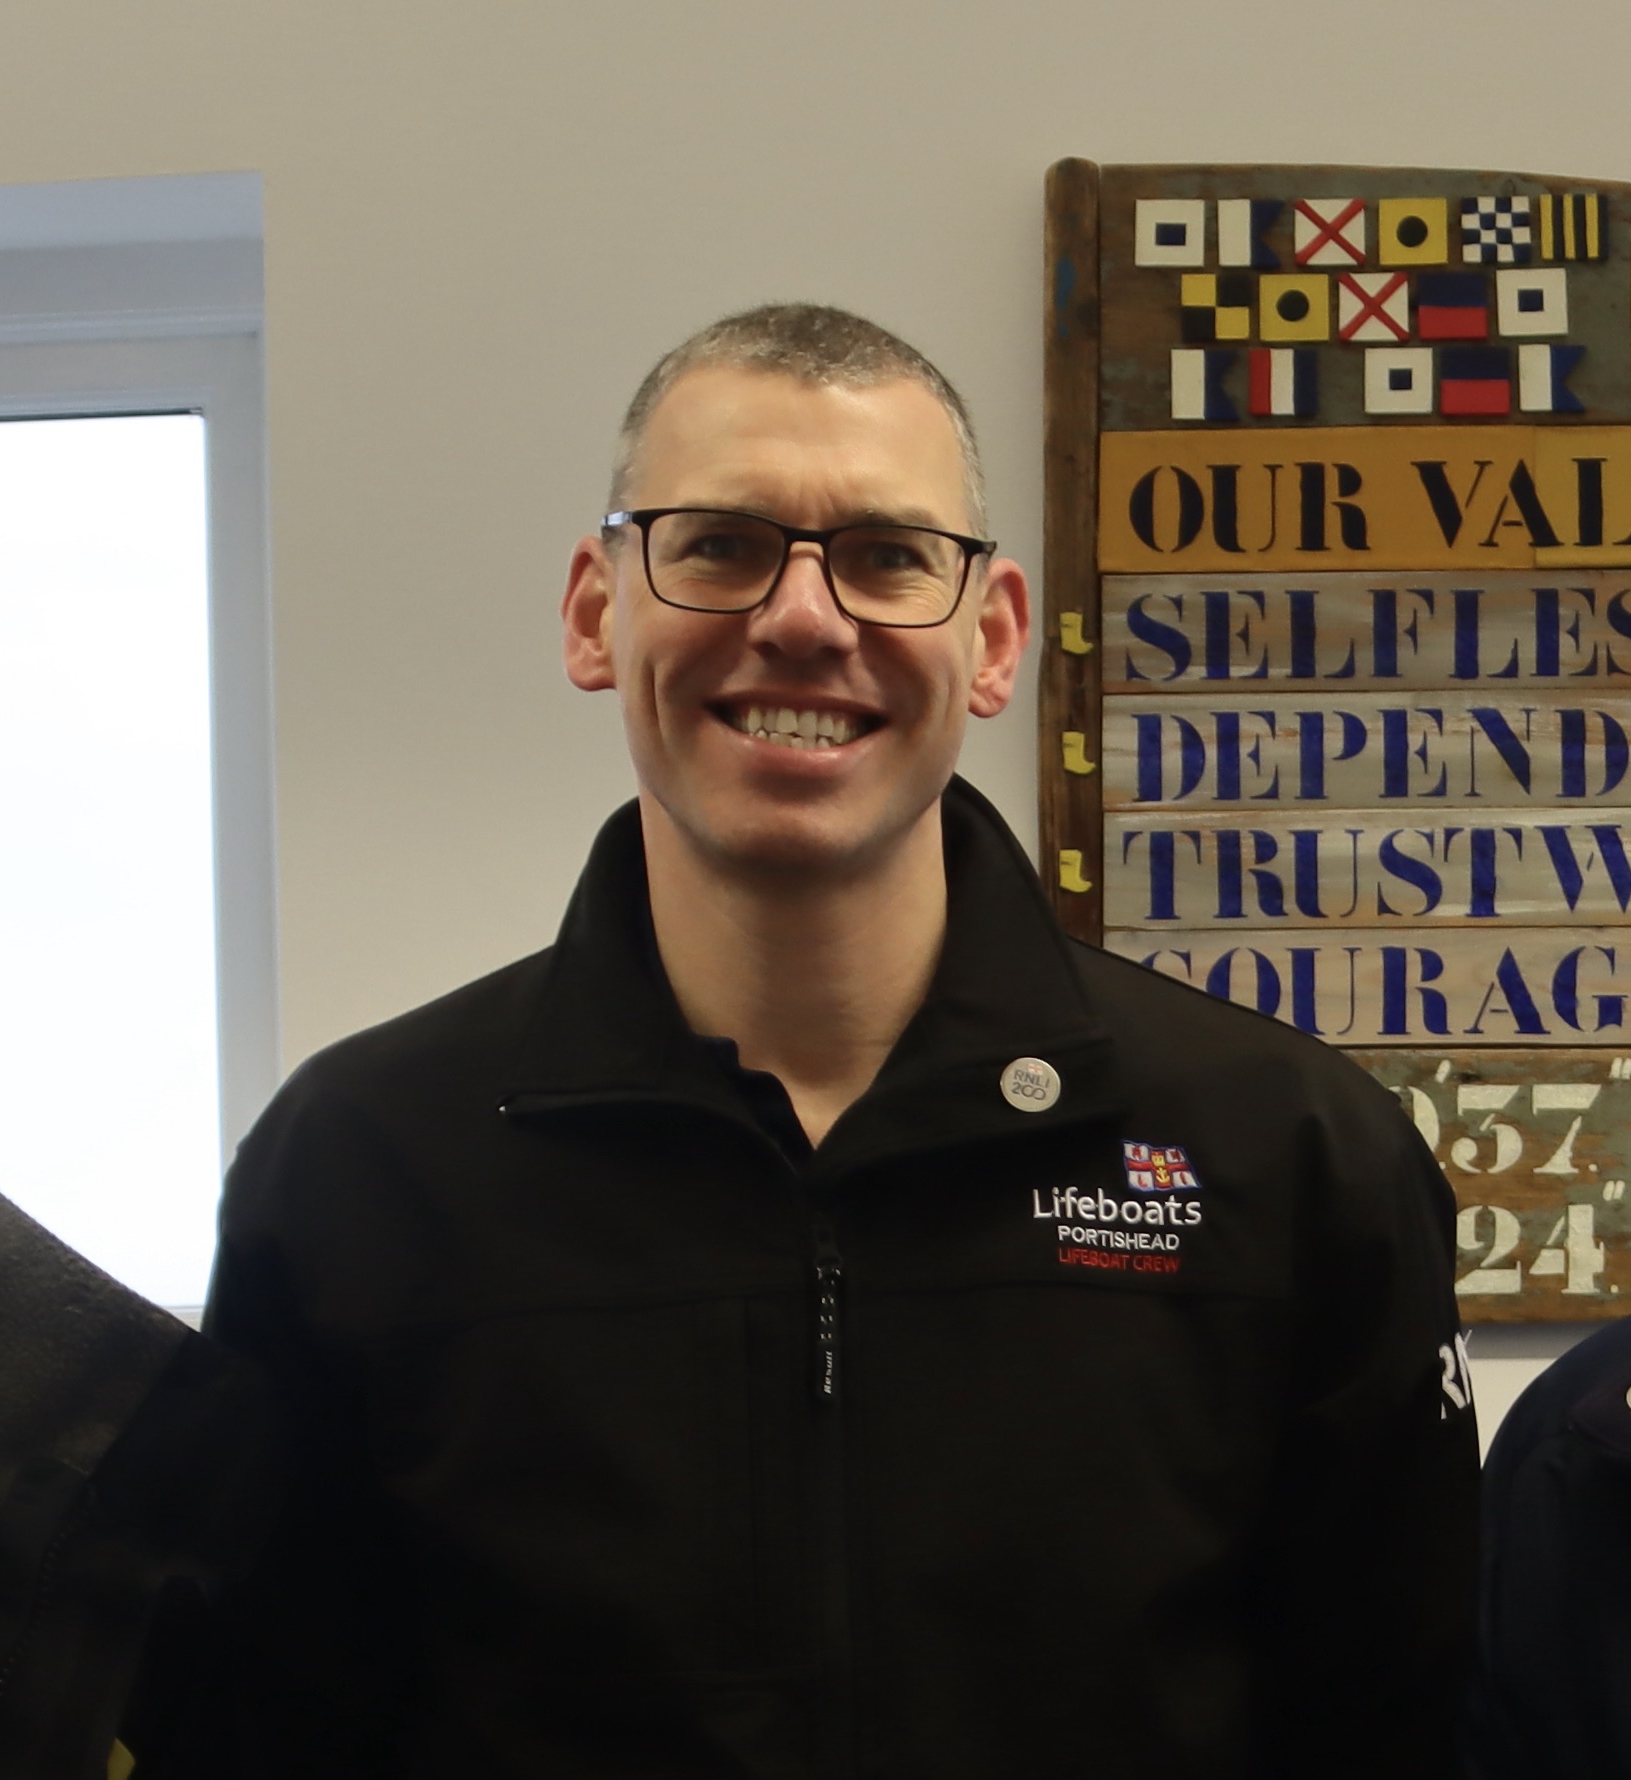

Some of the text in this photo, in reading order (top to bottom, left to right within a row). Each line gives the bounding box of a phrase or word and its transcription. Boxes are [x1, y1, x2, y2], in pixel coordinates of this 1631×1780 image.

[1128, 460, 1371, 554] OUR
[1013, 1069, 1050, 1089] RNLI
[1032, 1186, 1202, 1226] Lifeboats
[1057, 1225, 1181, 1251] PORTISHEAD
[1058, 1248, 1182, 1273] LIFEBOAT CREW
